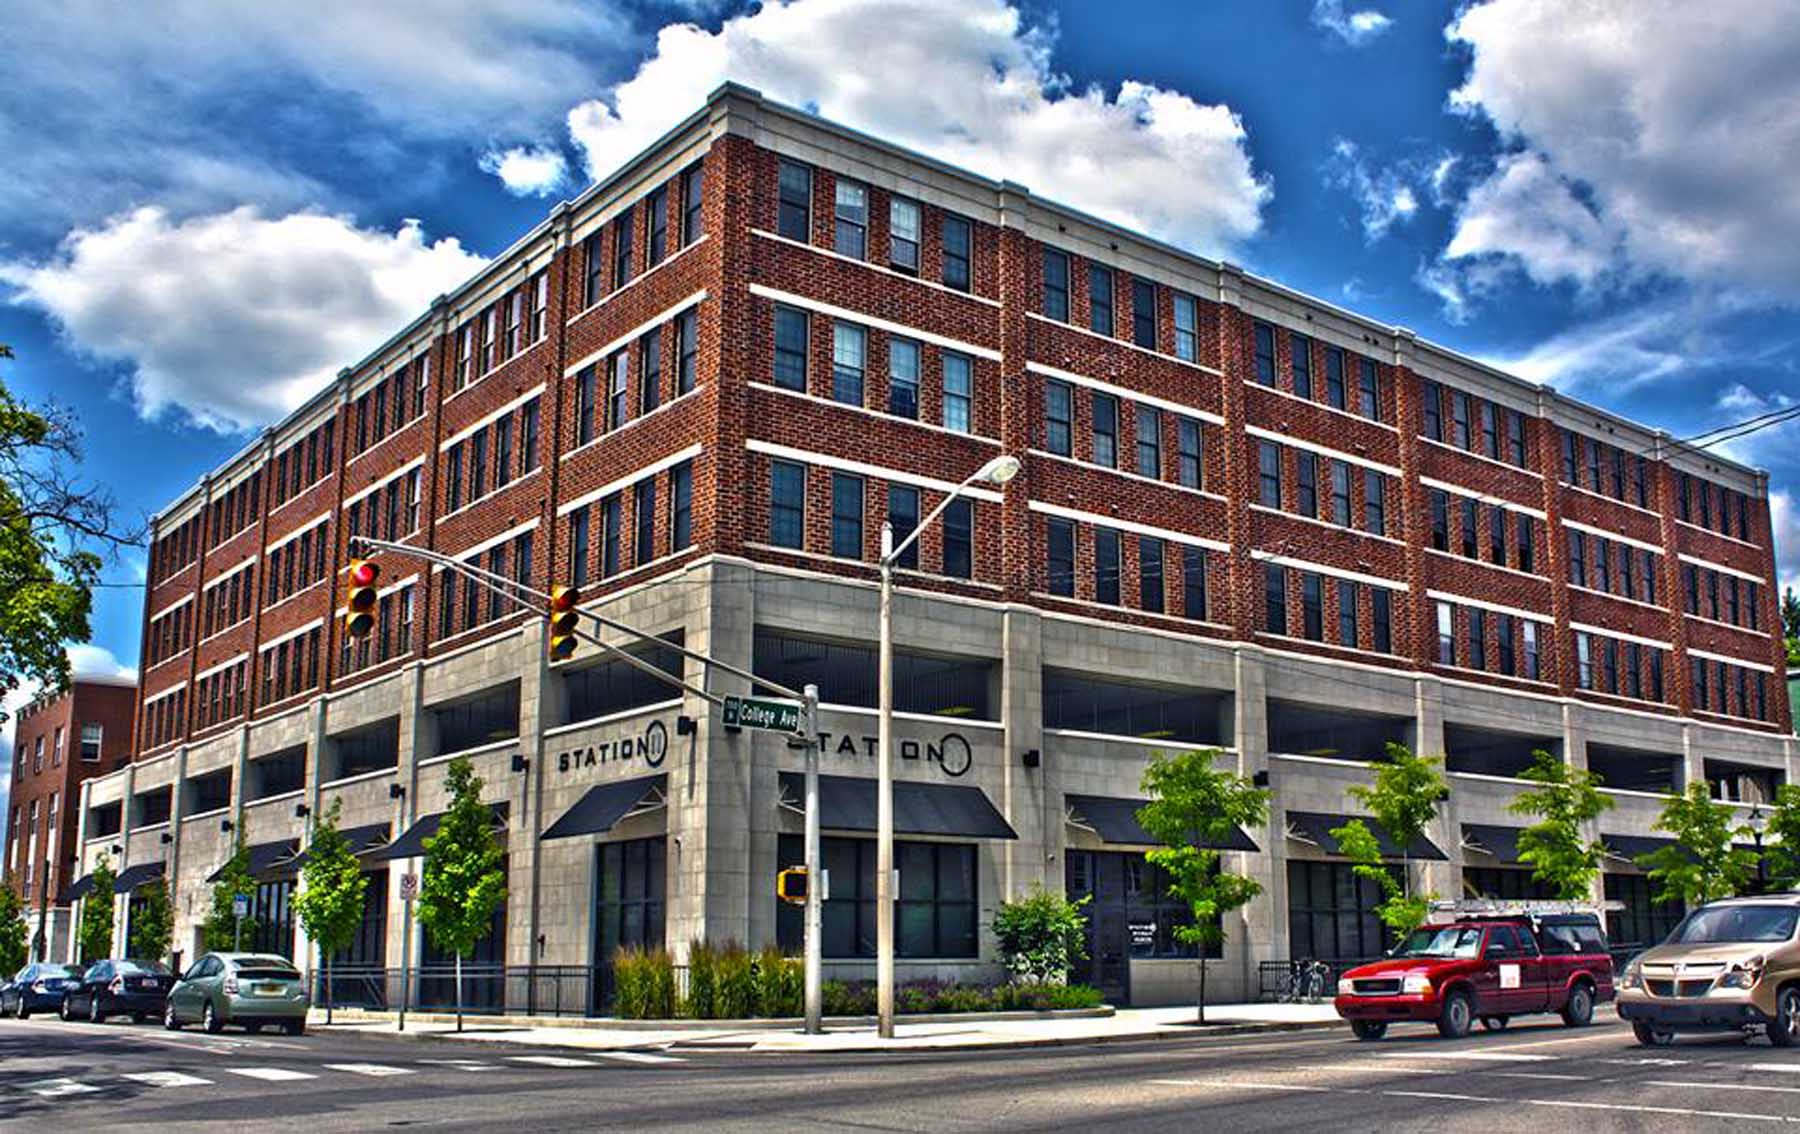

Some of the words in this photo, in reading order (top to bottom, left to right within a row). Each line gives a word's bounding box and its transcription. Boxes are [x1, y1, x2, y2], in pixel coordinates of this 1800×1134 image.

[741, 704, 776, 728] College
[780, 710, 797, 727] Ave
[559, 736, 649, 772] STATION
[787, 731, 945, 763] TATON
